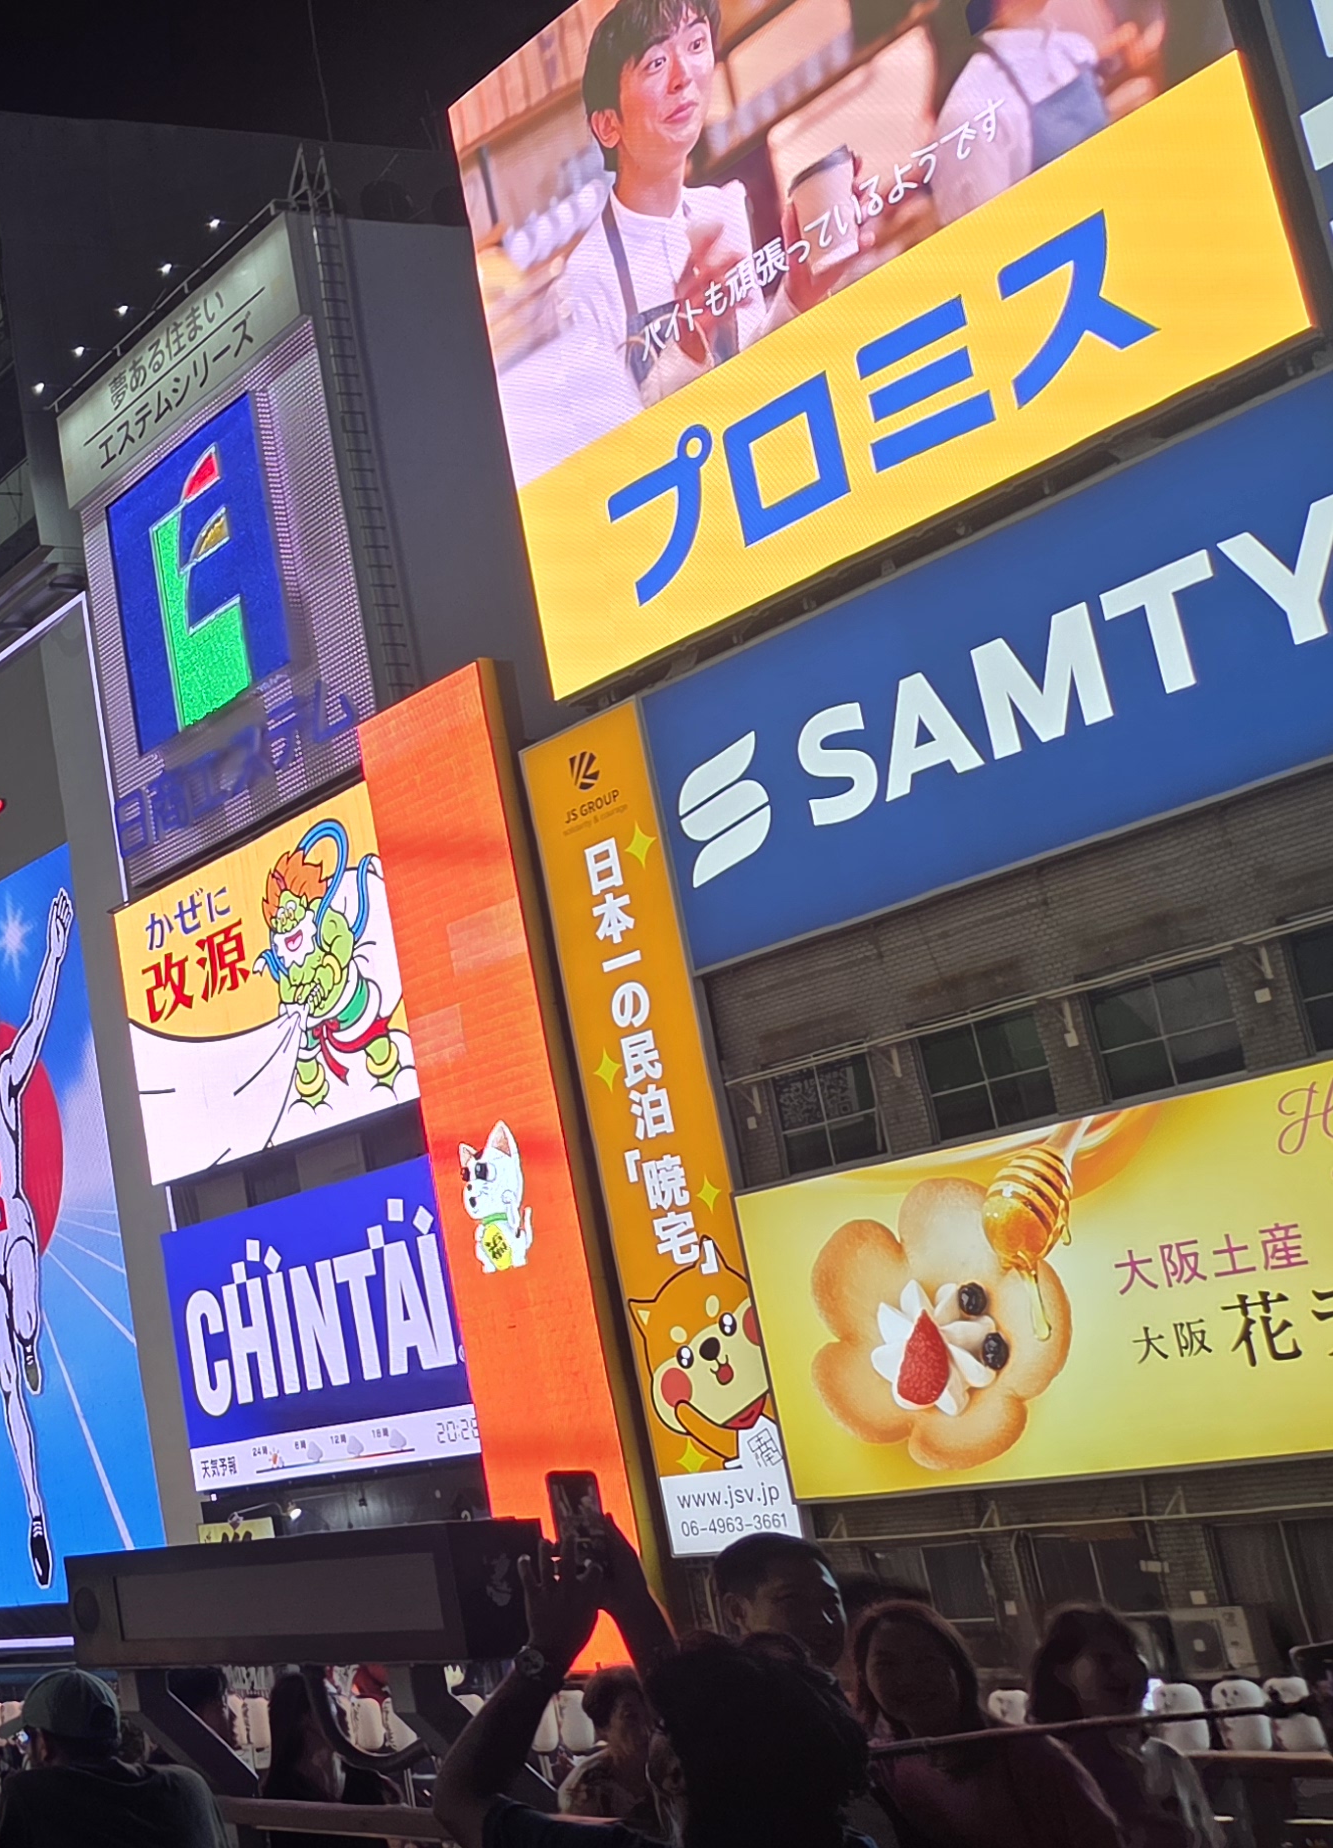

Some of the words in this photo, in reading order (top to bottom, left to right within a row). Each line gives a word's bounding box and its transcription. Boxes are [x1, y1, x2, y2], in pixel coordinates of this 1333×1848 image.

[641, 98, 1005, 362] バイトも頑張っているようです
[99, 314, 254, 470] エステムシリーズ
[108, 290, 225, 410] 夢ある住まい
[607, 209, 1161, 606] プロミス
[797, 494, 1333, 826] SAMTY
[565, 808, 578, 824] JS
[579, 789, 619, 817] GROUP
[144, 886, 231, 953] かぜに
[141, 920, 251, 1023] 改源
[1113, 1221, 1309, 1296] 大阪土産
[185, 1200, 459, 1419] CHINTAI
[1132, 1319, 1212, 1365] 大阪
[1220, 1288, 1333, 1368] 花
[200, 1456, 237, 1480] 天気予報
[677, 1482, 780, 1509] www.jsv.jp
[681, 1513, 787, 1538] 06-4963-3661
